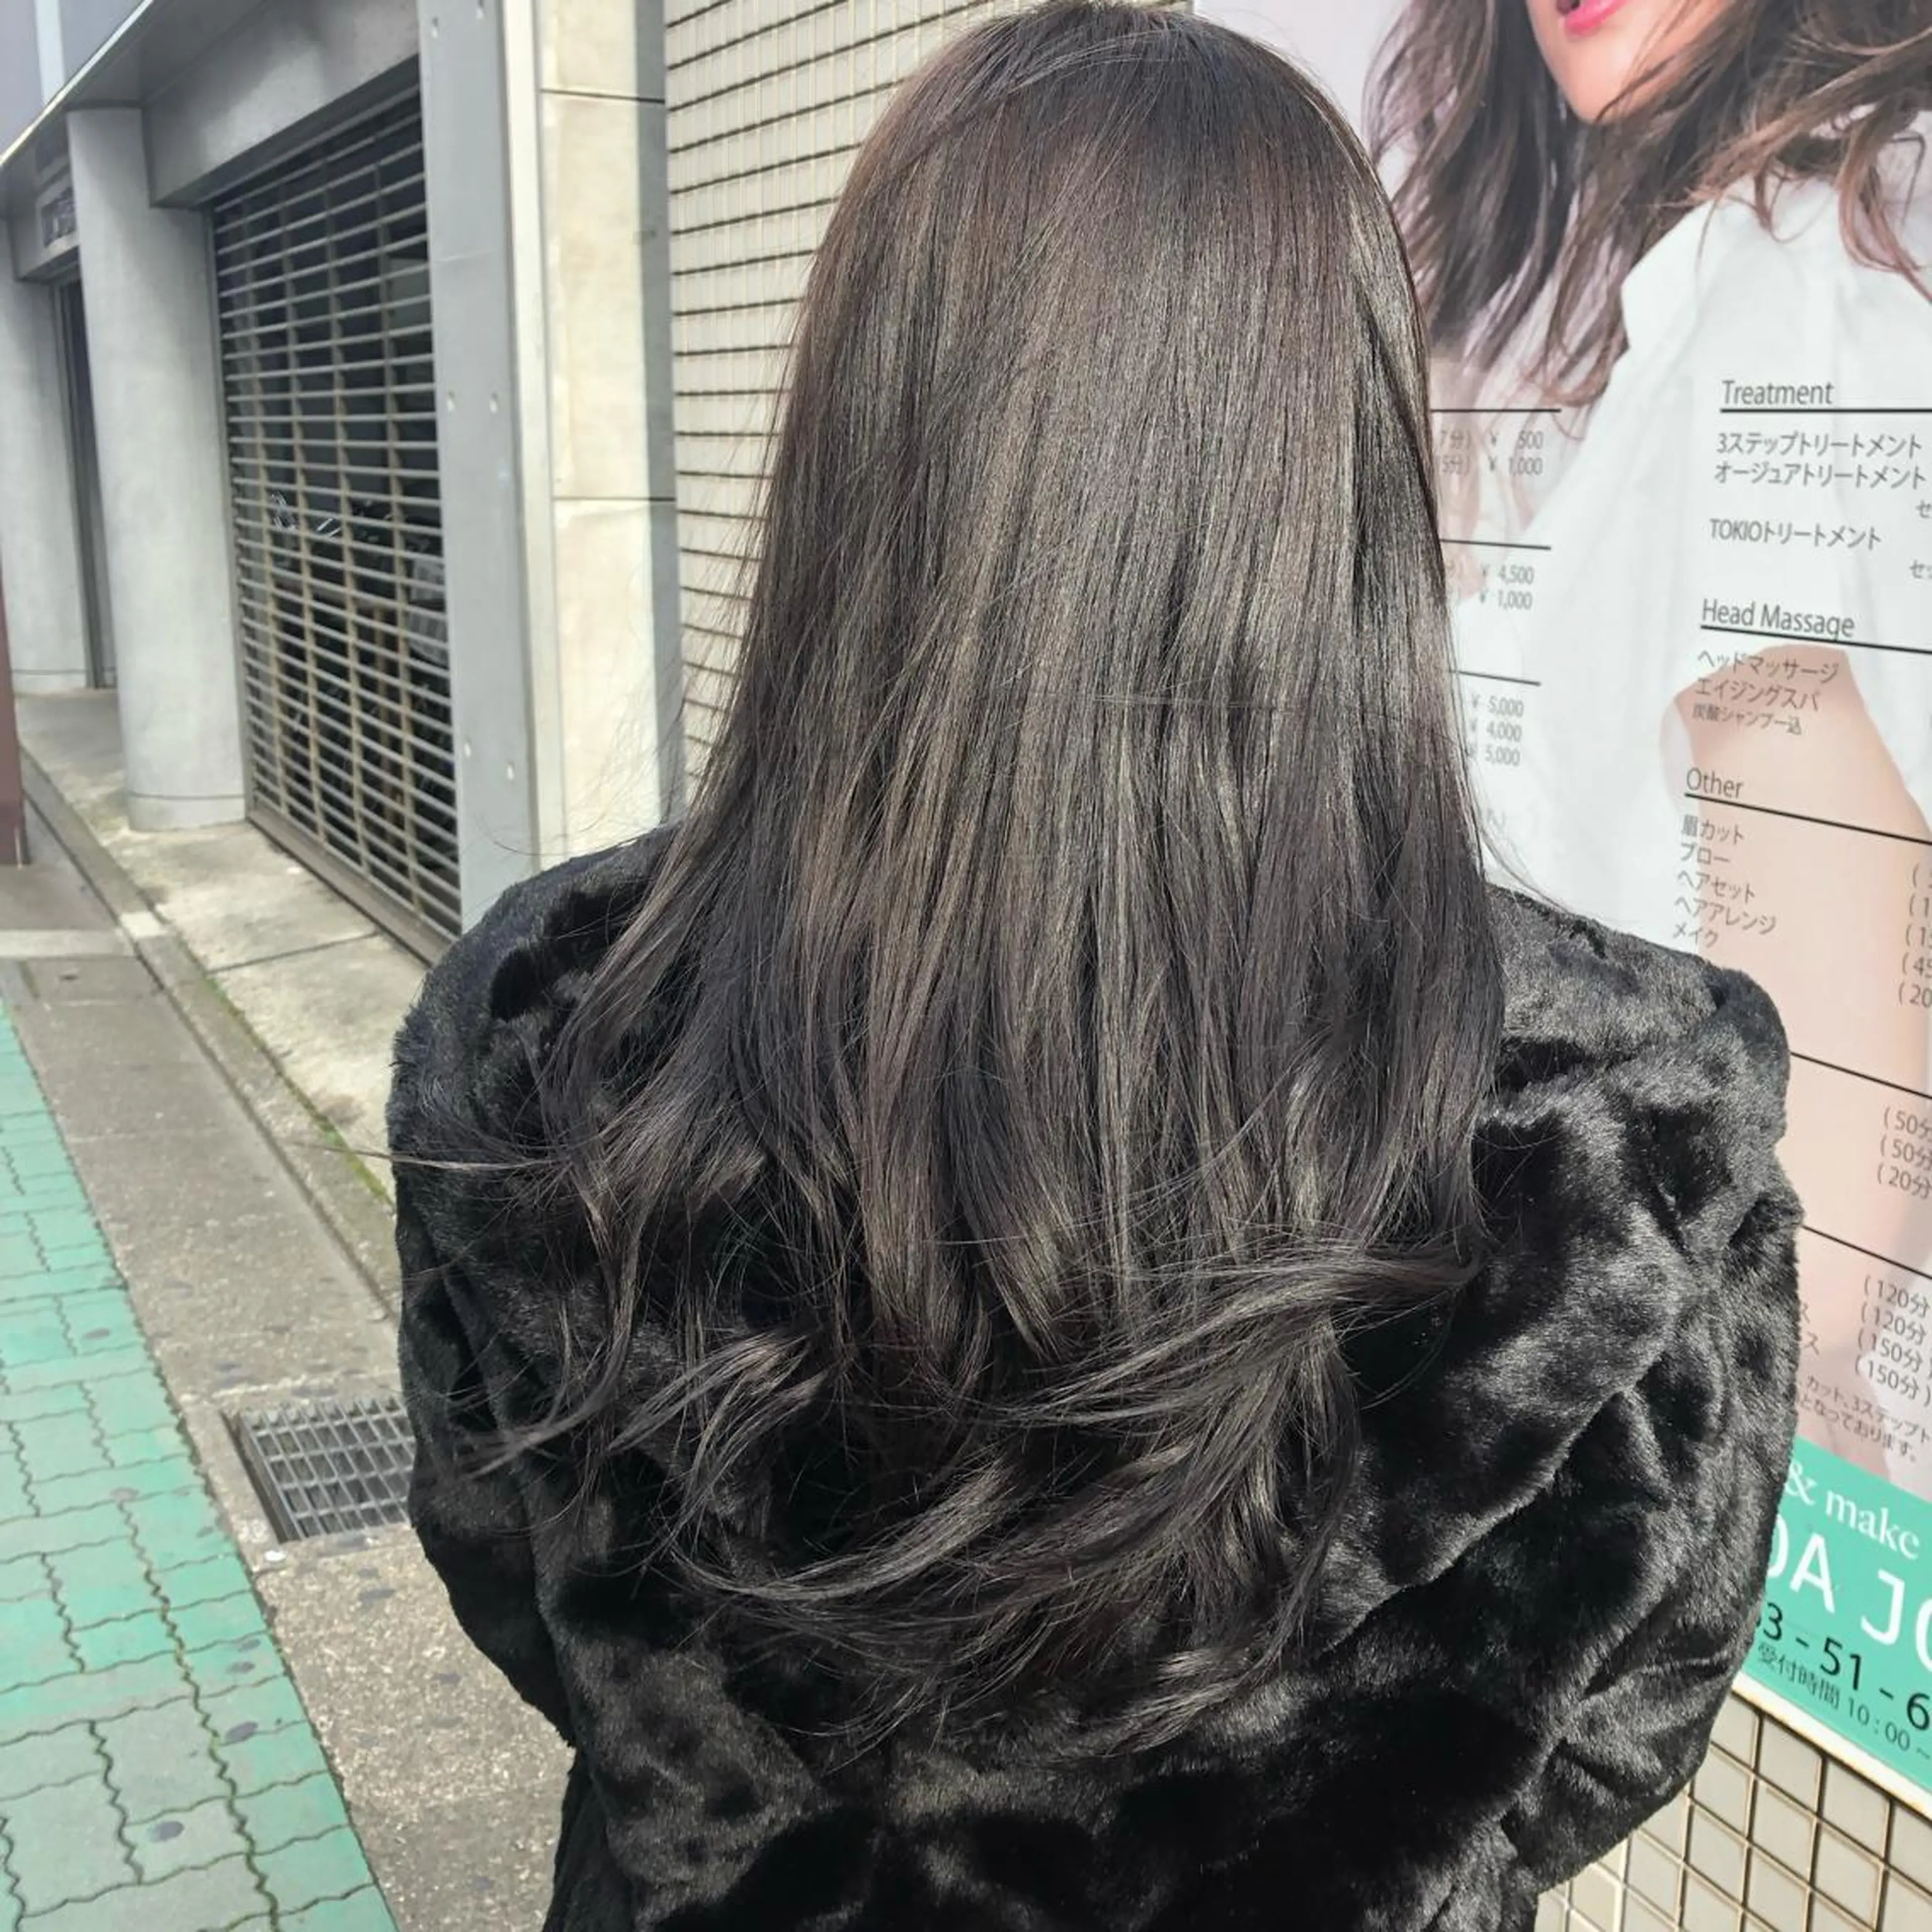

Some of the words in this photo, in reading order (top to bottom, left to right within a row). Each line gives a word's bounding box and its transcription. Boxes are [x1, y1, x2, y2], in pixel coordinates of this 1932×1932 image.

[1722, 380, 1835, 405] Treatment
[1517, 429, 1544, 449] 500
[1716, 429, 1922, 459] 3ステップトリートメント
[1509, 456, 1543, 474] 1,000
[1714, 460, 1926, 490] オージュアトリートメント
[1710, 518, 1881, 550] TOKIOトリートメント
[1498, 564, 1535, 585] 4,500
[1498, 589, 1533, 610] 1,000
[1702, 598, 1756, 626] Head
[1761, 604, 1856, 641] Massage
[1698, 650, 1839, 684] ヘッドマッサージ
[1487, 695, 1524, 718] 5,000
[1485, 720, 1523, 743] 4,000
[1484, 744, 1521, 768] 5,000
[1686, 767, 1744, 799] Other
[1681, 814, 1744, 845] 眉カット
[1680, 841, 1731, 865] ブロー
[1677, 870, 1755, 905] ヘアセット
[1674, 896, 1777, 935] ヘアアレンジ
[1672, 922, 1719, 948] メイク
[1825, 1489, 1920, 1560] make
